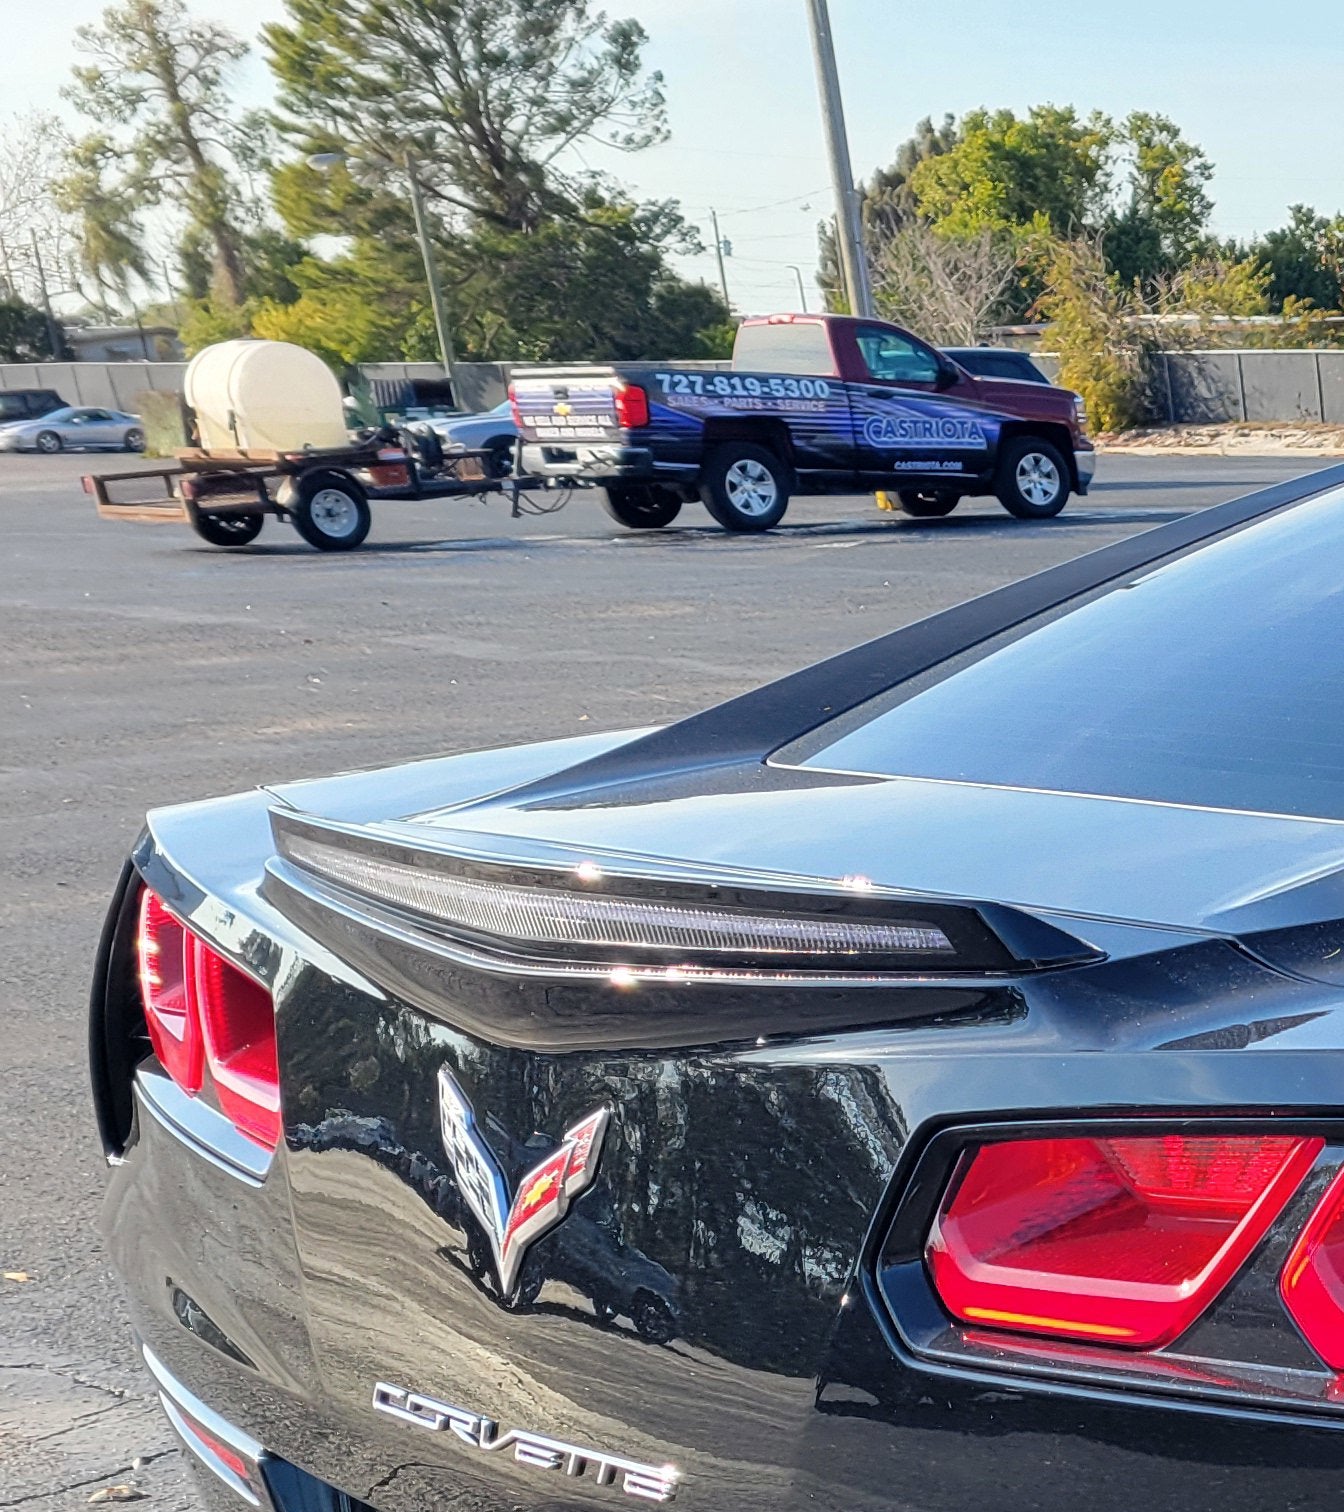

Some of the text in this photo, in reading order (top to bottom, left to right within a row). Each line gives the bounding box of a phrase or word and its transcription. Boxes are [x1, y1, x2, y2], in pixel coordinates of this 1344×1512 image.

[655, 373, 830, 398] 727-819-5300
[667, 396, 826, 412] SALES PARTS SERVICE
[864, 416, 986, 449] CASTRIOTA
[373, 1381, 678, 1501] CORVETTE
